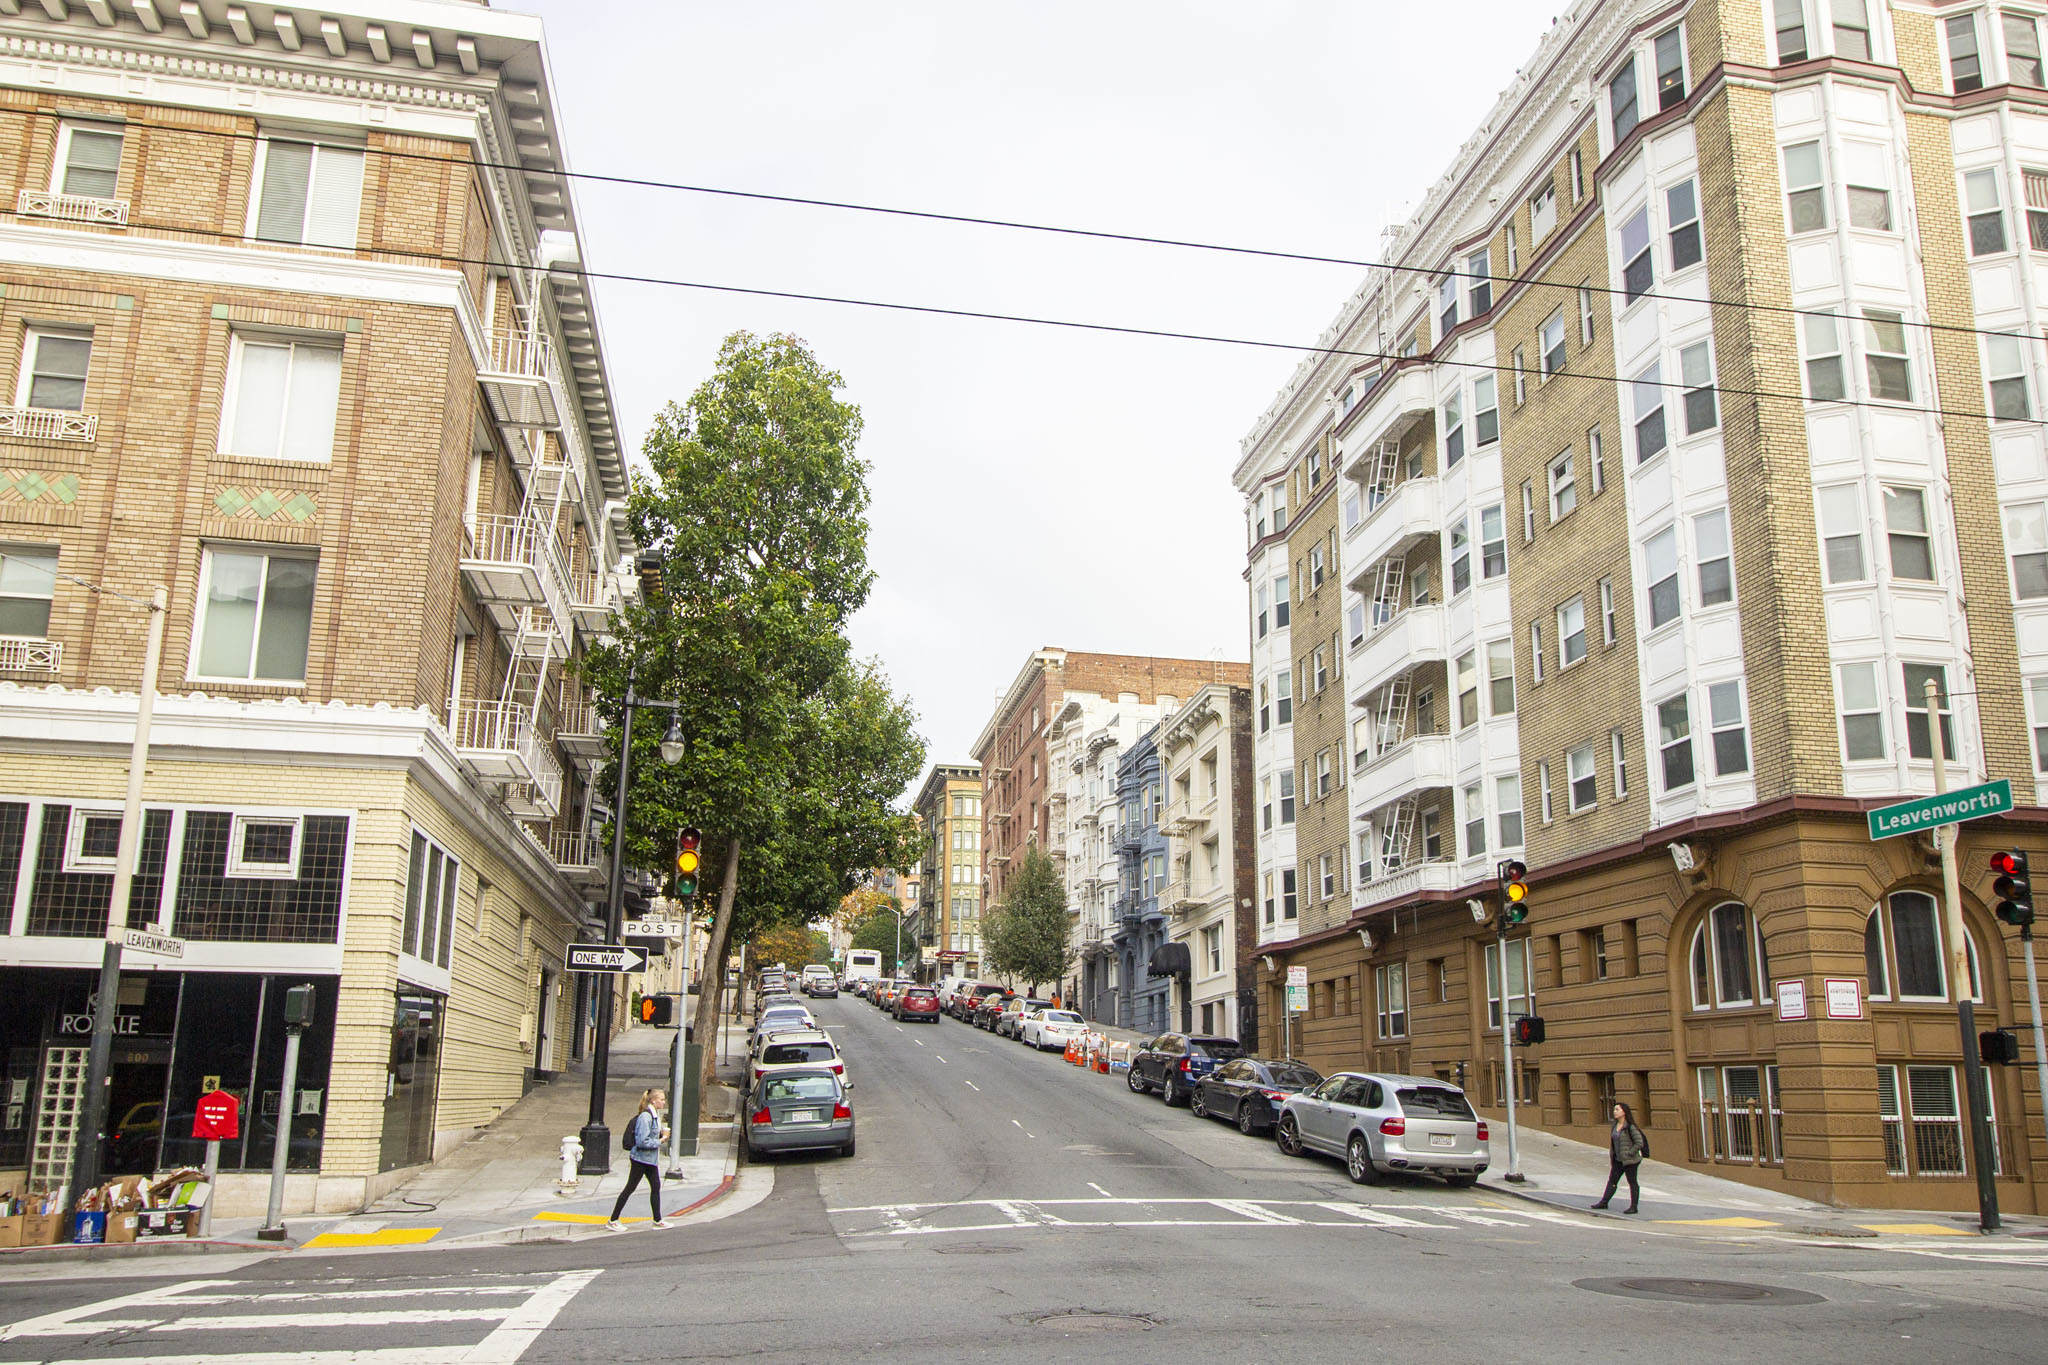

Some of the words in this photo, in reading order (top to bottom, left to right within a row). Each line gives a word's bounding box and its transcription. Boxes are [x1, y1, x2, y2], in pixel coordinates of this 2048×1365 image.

[1878, 790, 2001, 831] Leavenworth
[627, 923, 678, 934] POST
[126, 933, 181, 953] LEAVENWORTH
[575, 952, 597, 964] ONE
[600, 954, 624, 965] WAY
[62, 1015, 140, 1034] ROLE
